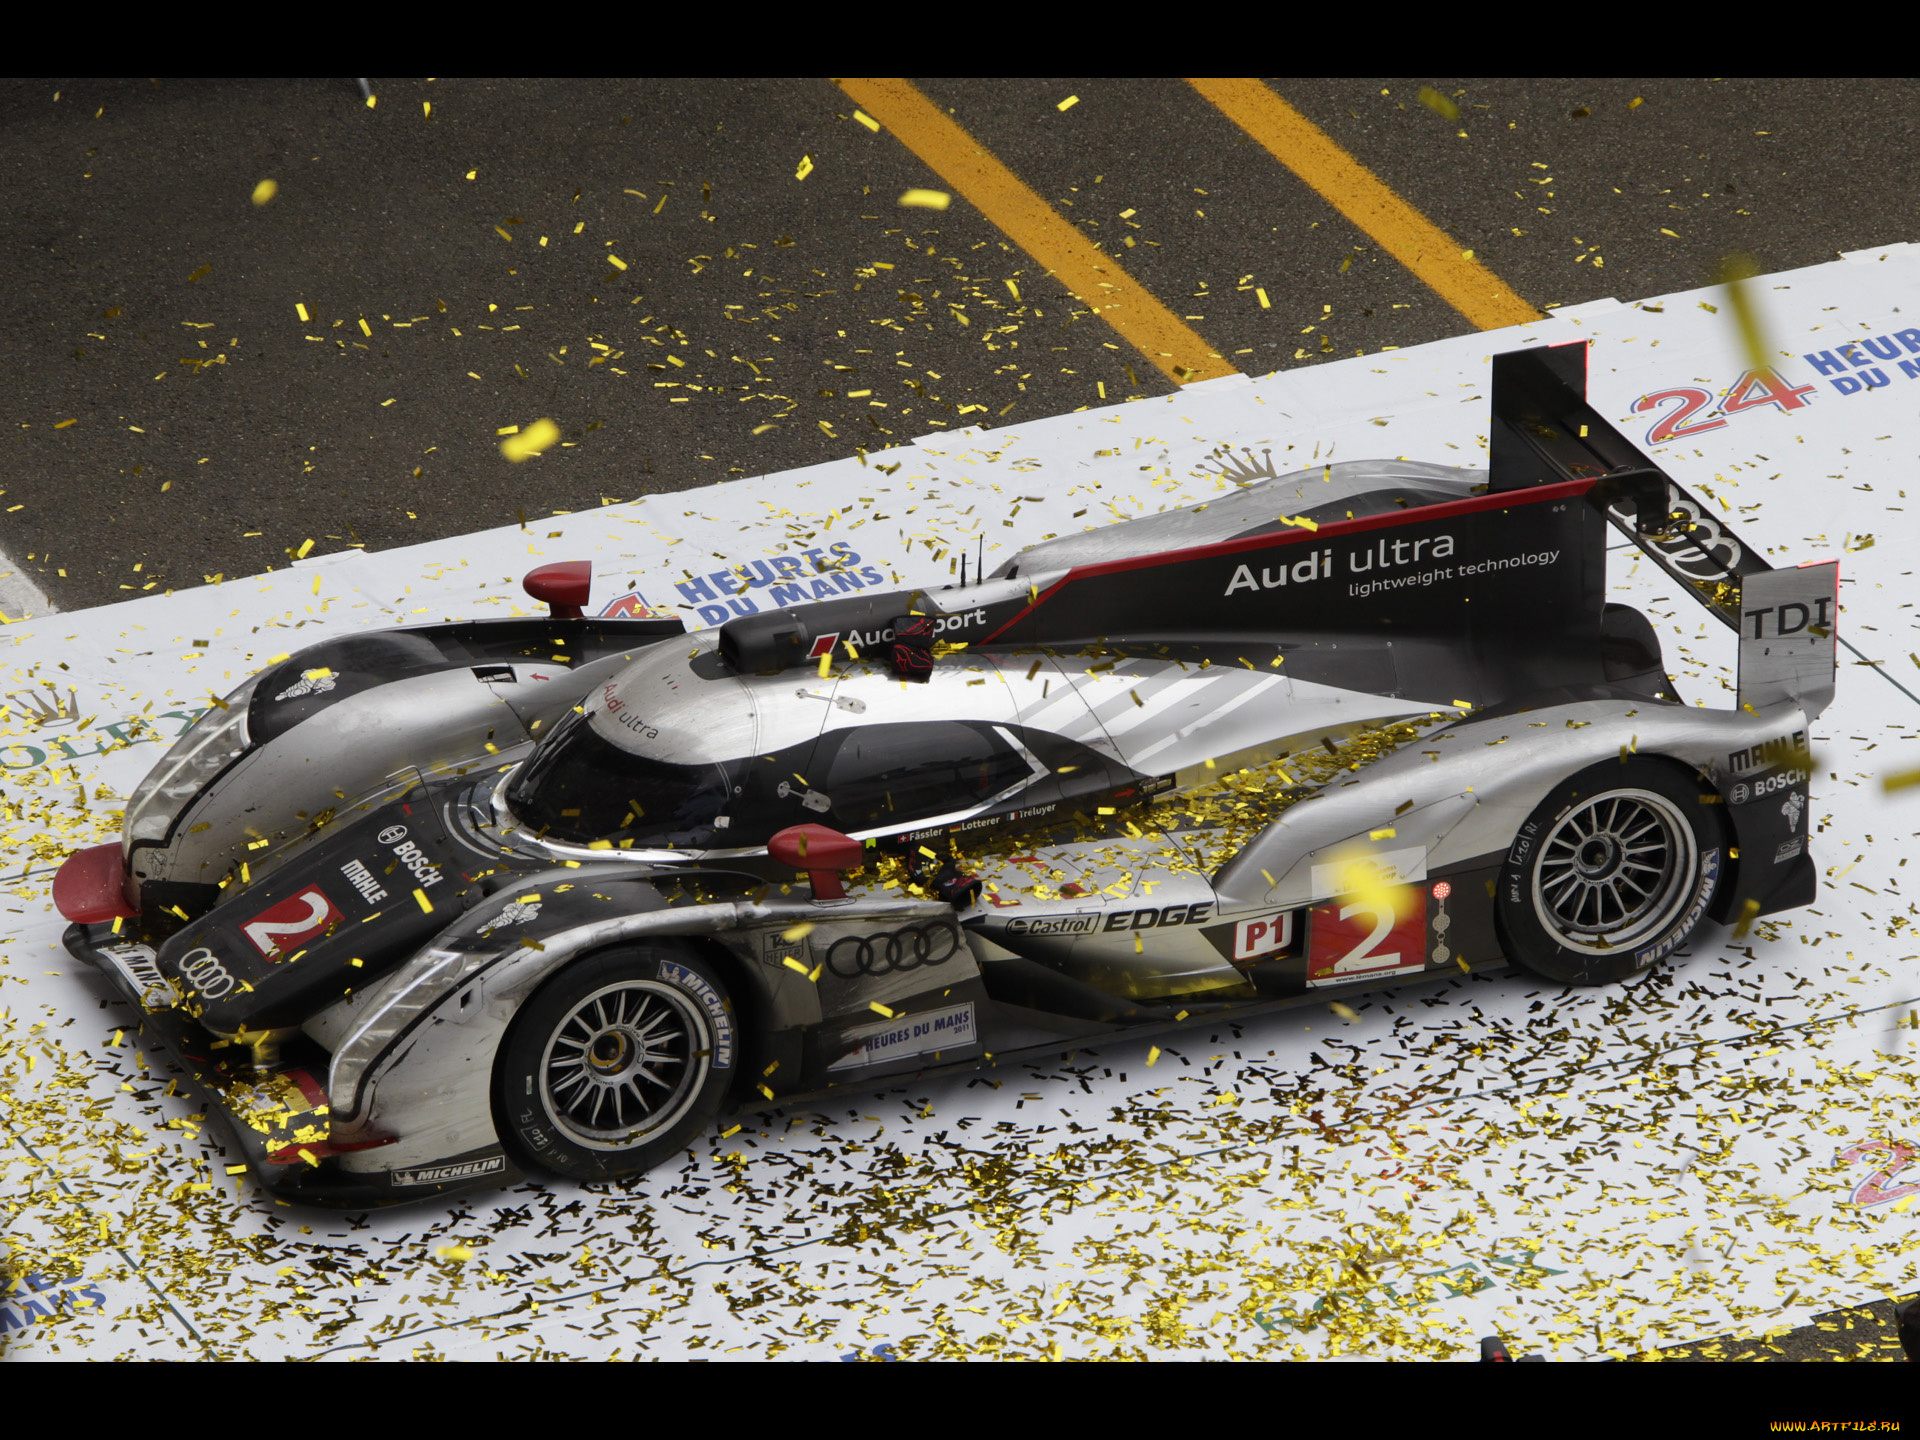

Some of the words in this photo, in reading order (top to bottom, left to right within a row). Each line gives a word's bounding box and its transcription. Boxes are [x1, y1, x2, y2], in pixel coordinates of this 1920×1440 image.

[1829, 367, 1891, 396] DU
[1630, 366, 1818, 446] 24
[674, 541, 861, 604] HEURES
[1224, 548, 1332, 597] Audi
[1350, 534, 1455, 573] ultra
[1349, 568, 1453, 597] lightweight
[1457, 550, 1560, 578] technology
[697, 597, 760, 626] DU
[769, 566, 884, 607] MANS
[1744, 597, 1832, 640] TDI
[844, 628, 896, 650] Aud
[931, 609, 986, 638] port
[604, 684, 626, 714] Audi
[618, 712, 659, 739] ultra
[1755, 768, 1807, 796] BOSCH
[909, 829, 943, 842] Fässler
[961, 817, 1000, 831] Lotterer
[1019, 803, 1057, 818] Tréluyer
[341, 859, 389, 905] MAHLE
[393, 840, 444, 888] BOSCH
[244, 892, 330, 957] 2
[1029, 917, 1091, 934] Castrol
[1102, 901, 1215, 933] EDGE
[1246, 914, 1284, 952] P1
[1334, 900, 1401, 974] 2
[1640, 878, 1714, 966] MICHELIN
[681, 973, 731, 1065] MICHELIN
[865, 1030, 910, 1051] HEURES
[913, 1022, 930, 1038] DU
[934, 1010, 970, 1031] MANS
[953, 1023, 970, 1035] 2011
[416, 1159, 501, 1181] MICHELIN
[1830, 1138, 1920, 1210] 2
